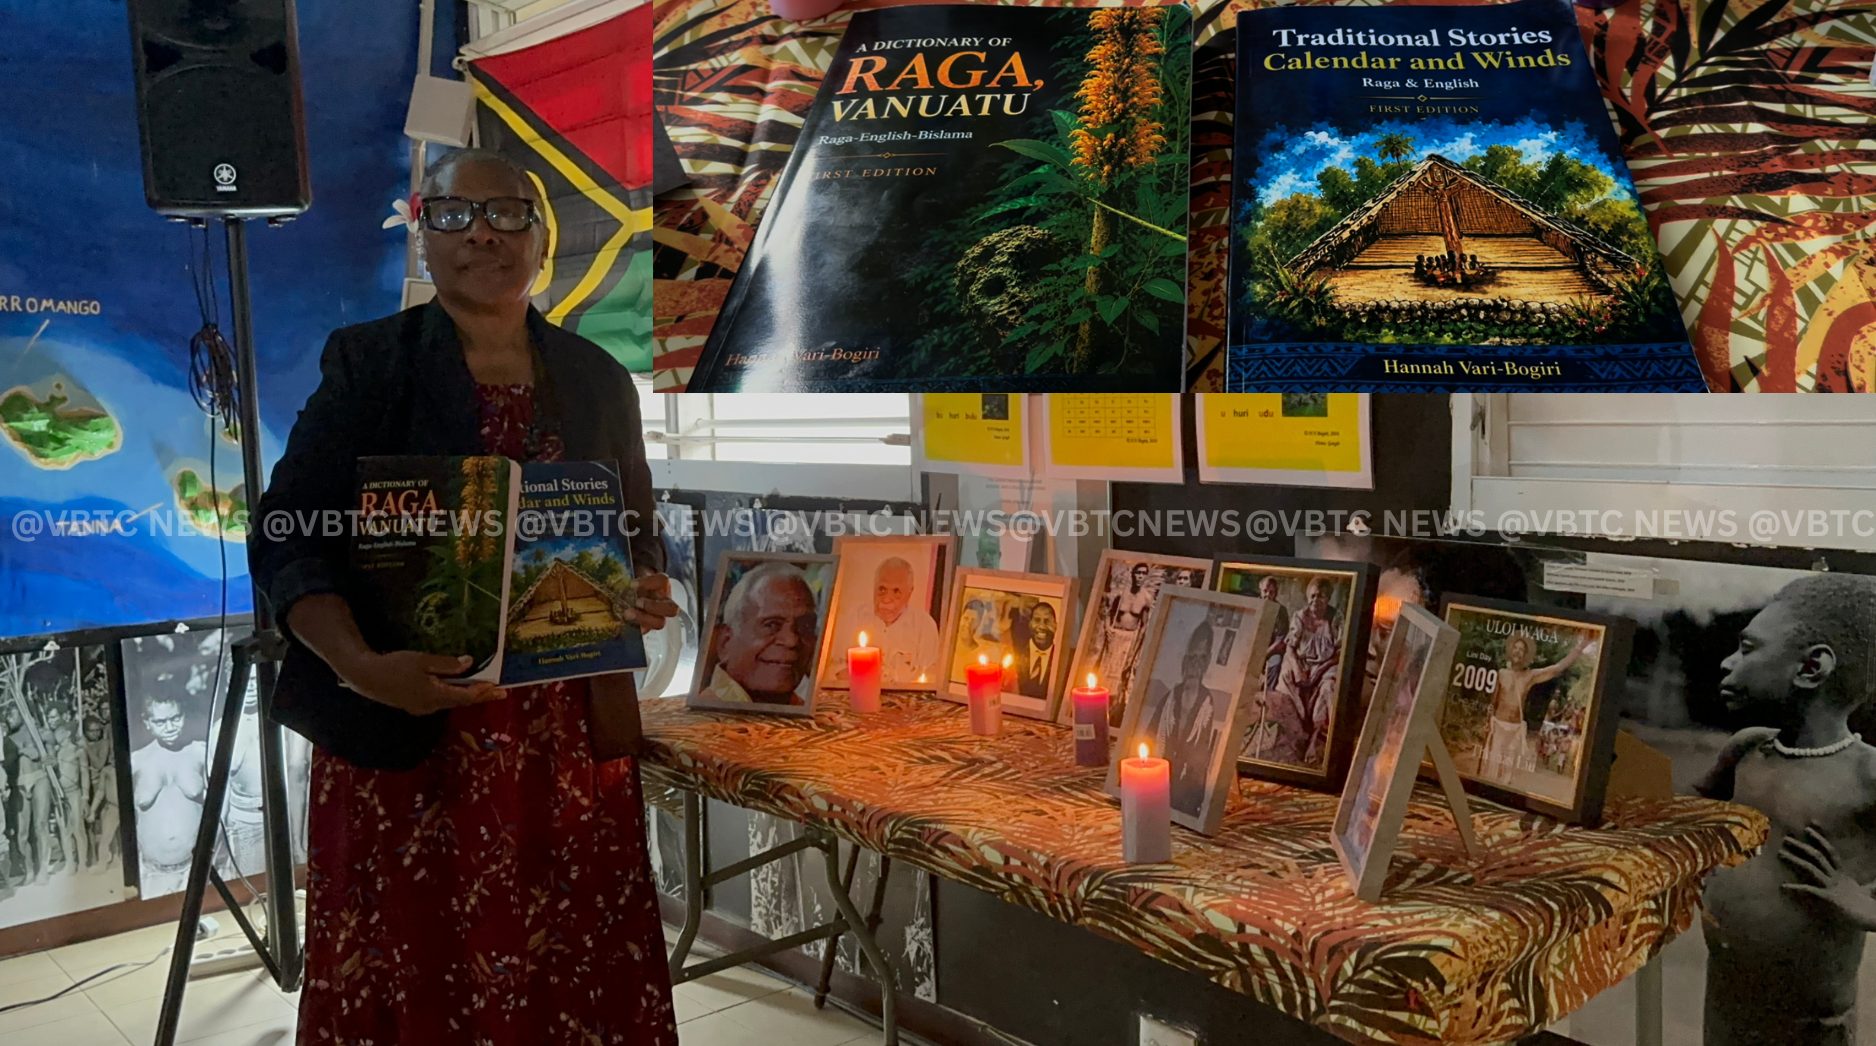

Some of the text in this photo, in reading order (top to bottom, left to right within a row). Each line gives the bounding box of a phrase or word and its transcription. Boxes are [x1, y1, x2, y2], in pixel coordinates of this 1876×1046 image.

[855, 37, 1012, 53] A DICTIONARY OF
[1272, 26, 1553, 48] Traditional Stories
[1263, 48, 1572, 71] Calendar and Winds
[835, 51, 1045, 95] RAGA,
[1362, 77, 1480, 91] Raga & English
[831, 92, 1032, 122] VANUATU
[1369, 104, 1480, 114] FIRST EDITION
[818, 129, 973, 146] Raga-English-Bislama
[815, 167, 938, 180] IRST EDITION
[1383, 359, 1562, 379] Hannah Vari-Bogiri
[369, 480, 417, 489] DICTIONARY
[561, 477, 608, 491] Stories
[544, 494, 570, 508] and
[573, 492, 616, 506] Winds
[55, 518, 124, 537] TANNA
[1486, 618, 1559, 644] ULOI WAGA
[1453, 662, 1498, 694] 2009
